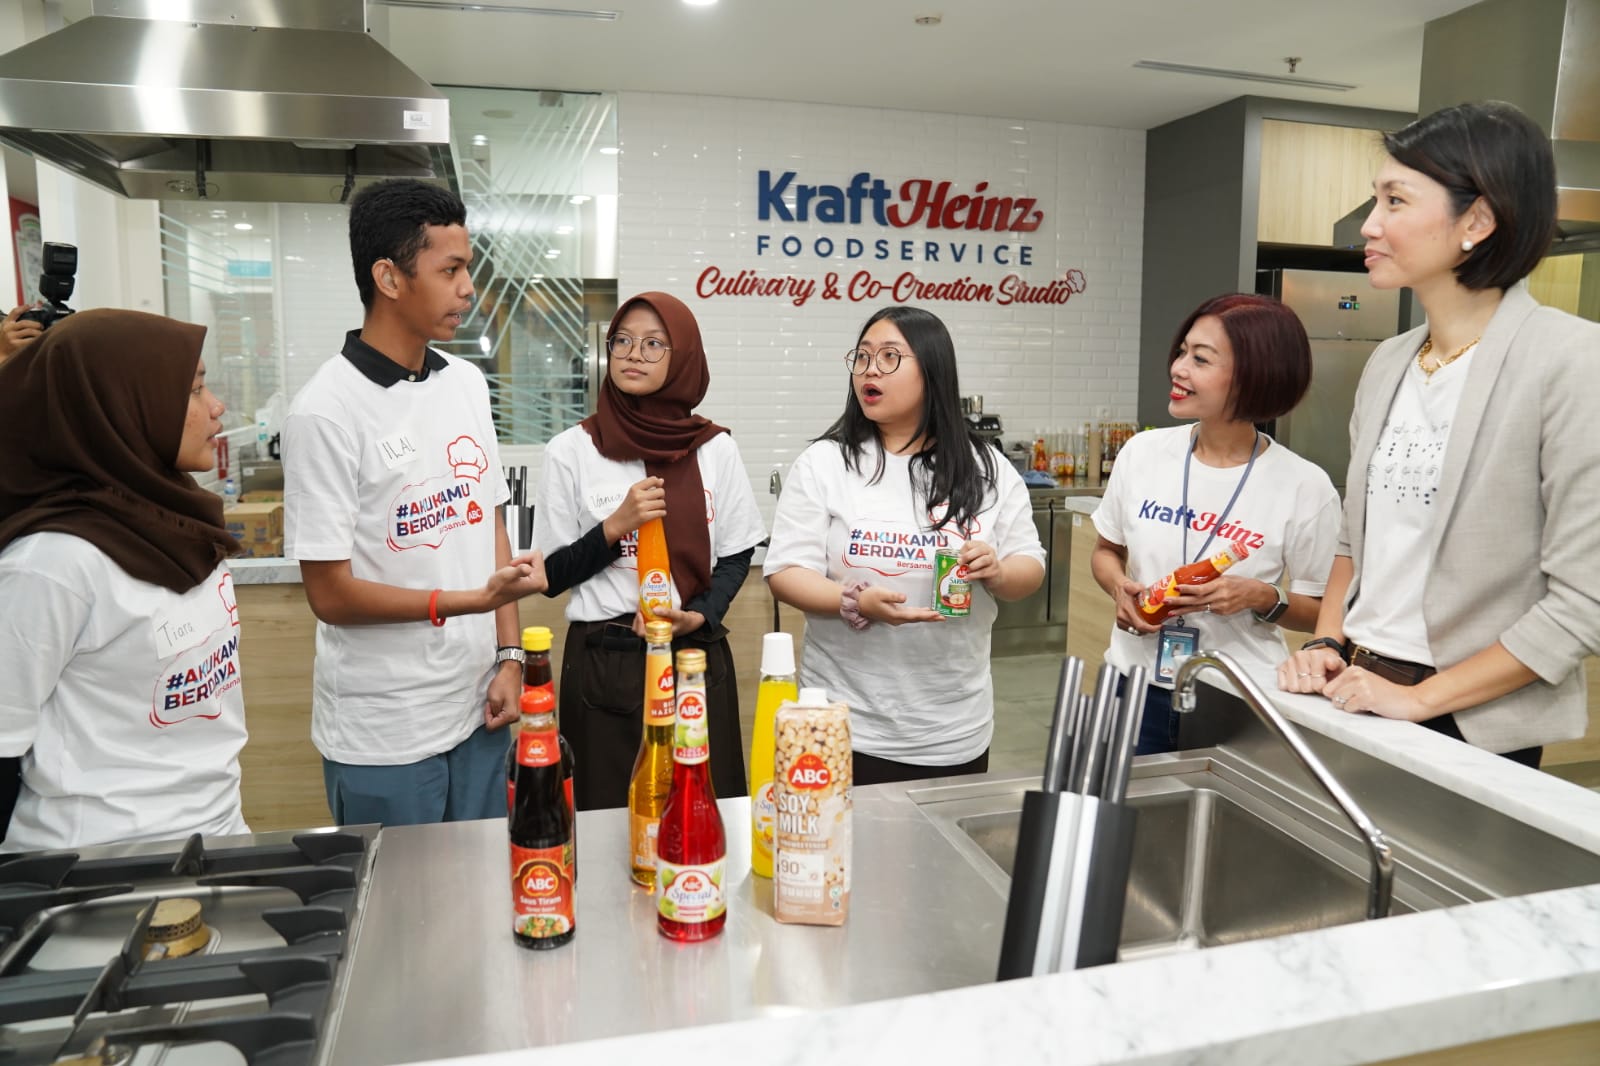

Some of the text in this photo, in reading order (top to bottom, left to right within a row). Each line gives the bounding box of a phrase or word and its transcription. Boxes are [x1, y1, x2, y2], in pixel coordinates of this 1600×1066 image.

[757, 235, 1032, 265] FOODSERVICE
[696, 266, 1070, 306] Culinary & Co-Creation Studio
[396, 483, 470, 518] #AKUKAMU
[397, 505, 457, 537] BERDAYA
[851, 528, 948, 548] #AKUKAMU
[849, 543, 927, 560] BERDAYA
[896, 561, 933, 570] Bersama
[166, 635, 238, 691] #AKUKAM
[165, 661, 236, 711] BERDAYA
[660, 676, 674, 688] AB
[681, 705, 703, 715] ABC
[792, 769, 828, 784] ABC
[780, 792, 810, 814] SOY
[780, 815, 818, 835] MILK
[526, 878, 554, 890] ABC
[671, 887, 712, 903] Special
